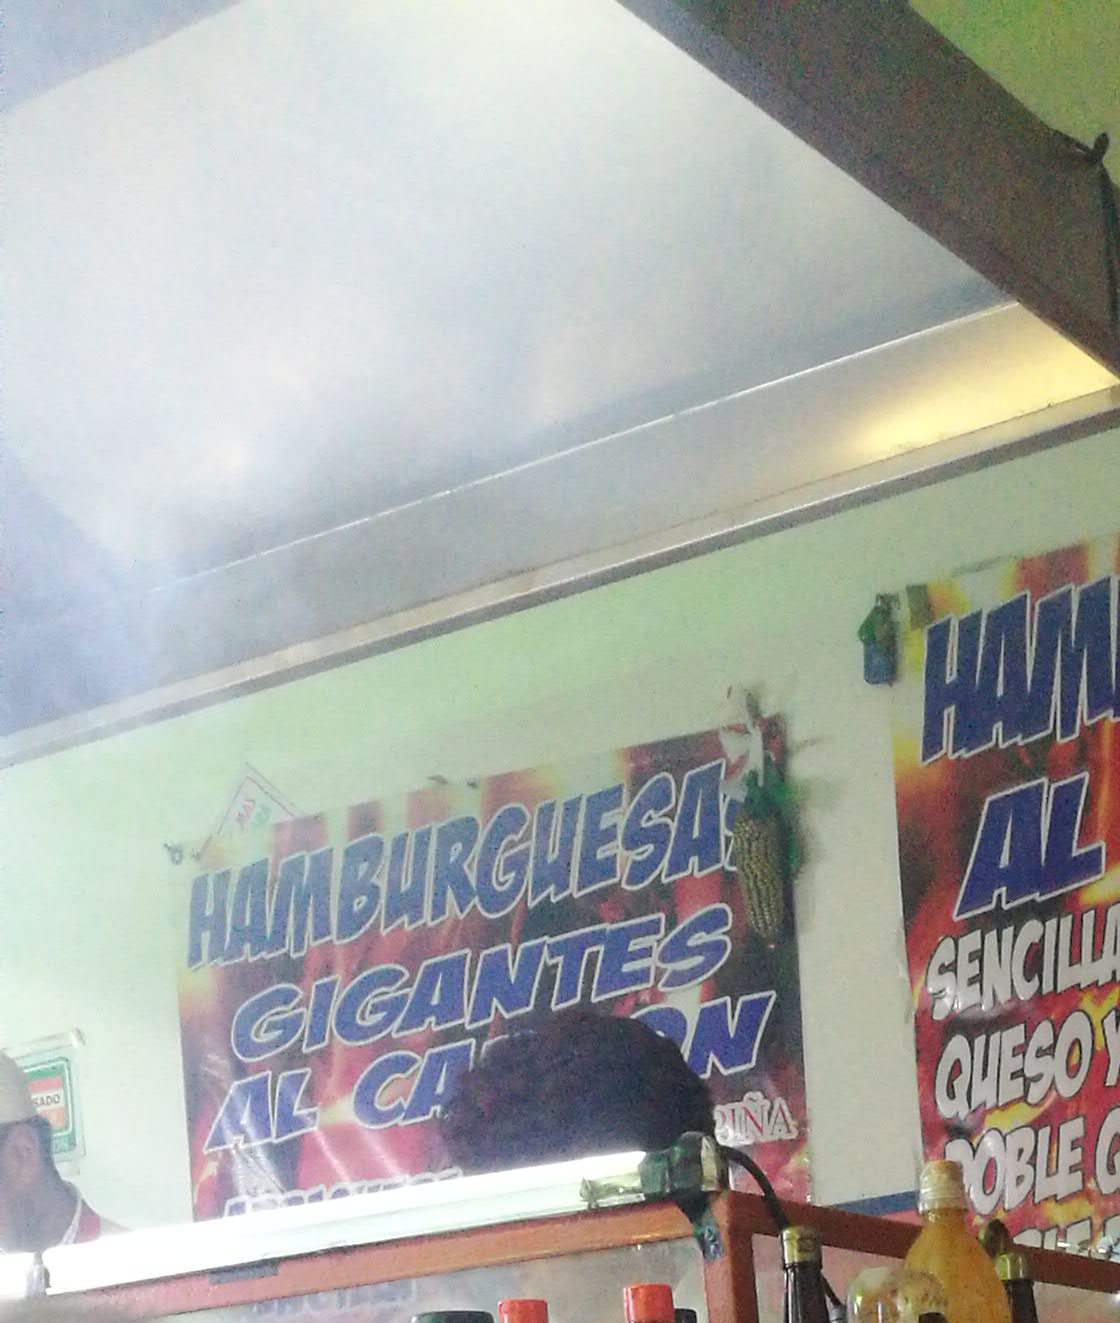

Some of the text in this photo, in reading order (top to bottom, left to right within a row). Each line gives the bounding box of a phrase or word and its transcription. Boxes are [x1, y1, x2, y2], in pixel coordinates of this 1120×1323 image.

[952, 770, 1107, 922] AL
[230, 901, 734, 1064] GIGANTES
[203, 989, 777, 1155] AL CAN
[934, 1009, 1095, 1119] QUESO
